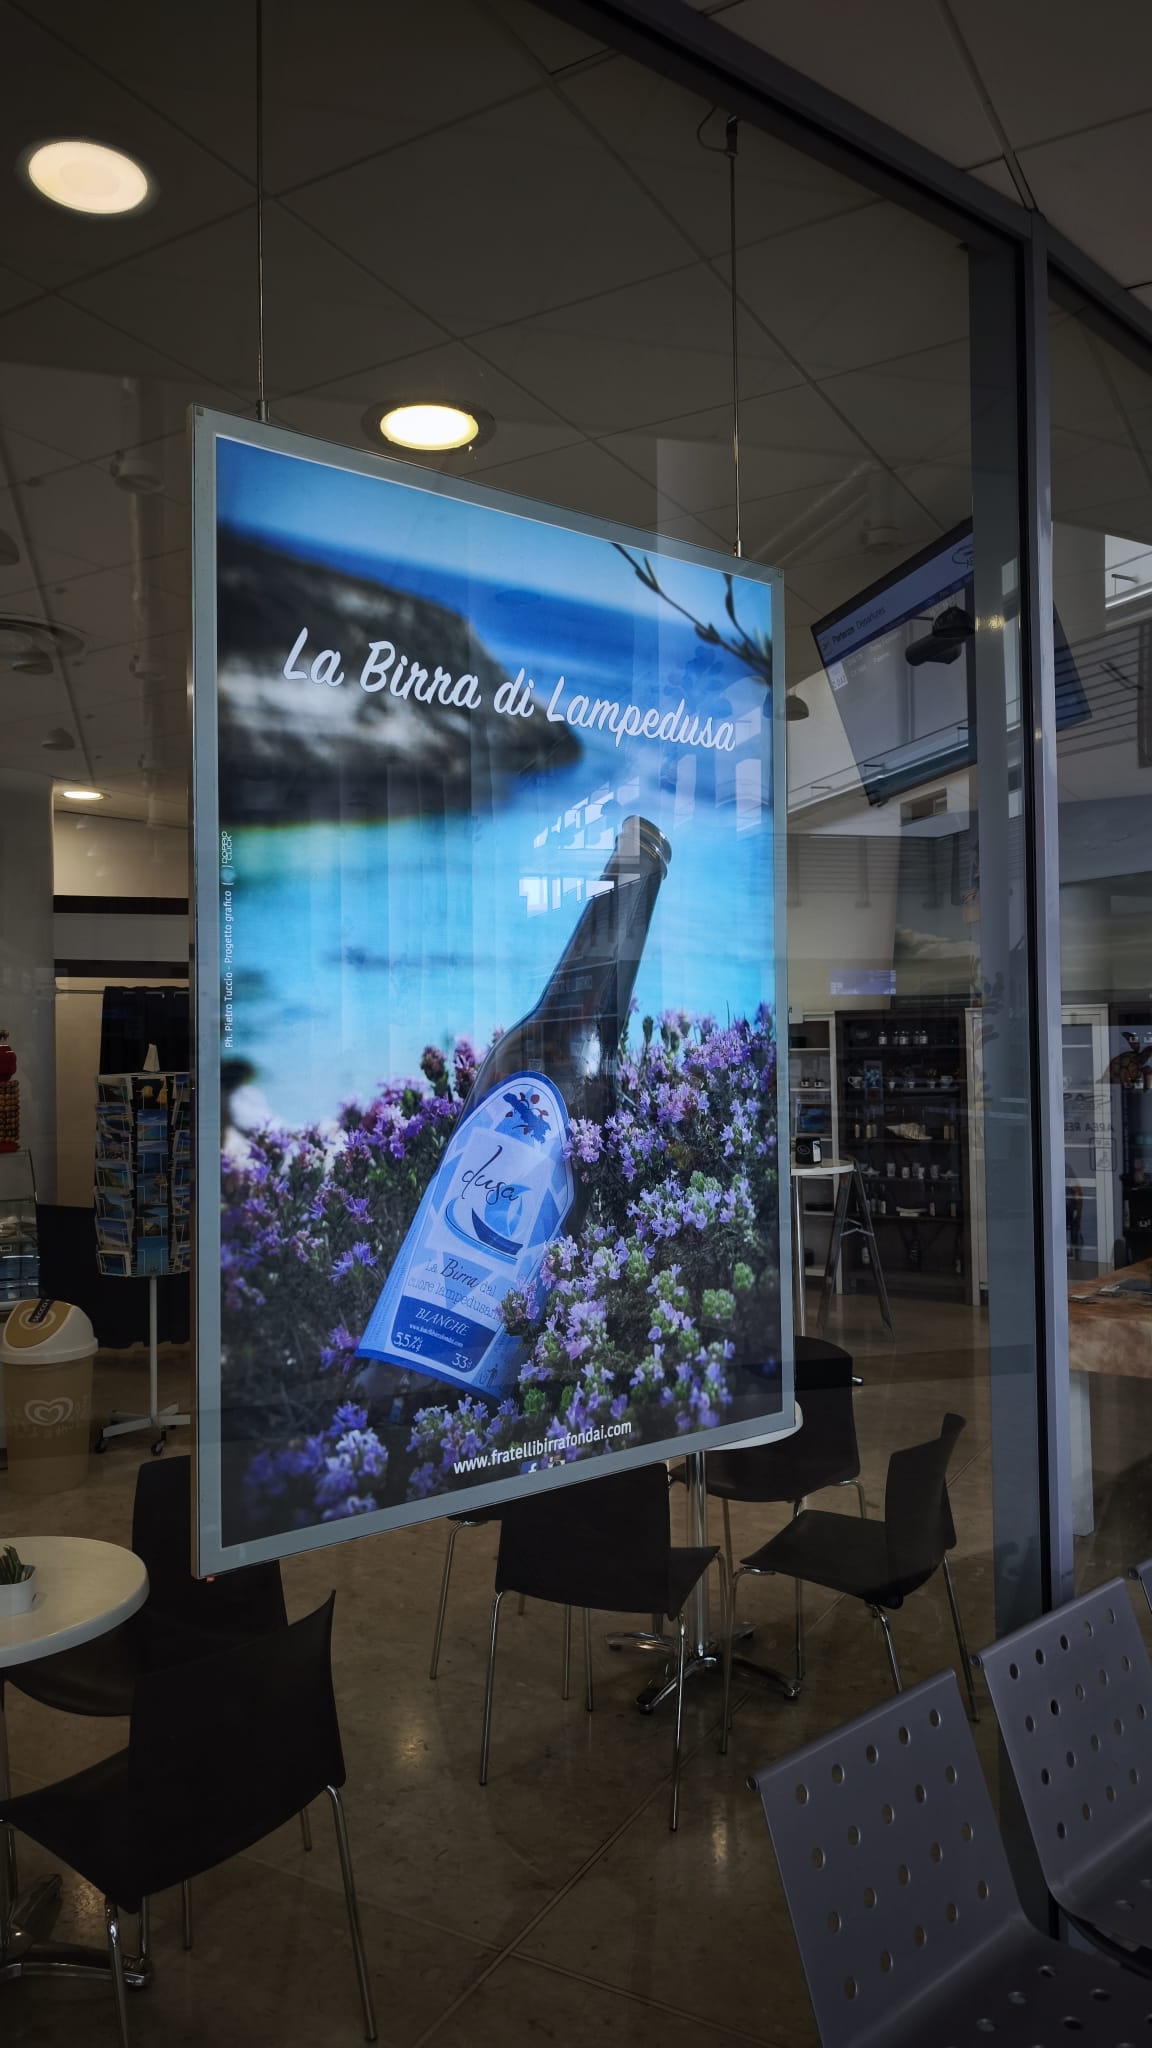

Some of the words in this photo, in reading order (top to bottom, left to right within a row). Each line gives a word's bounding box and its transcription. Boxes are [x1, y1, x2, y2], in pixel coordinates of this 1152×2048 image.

[283, 627, 345, 687] La
[359, 640, 482, 710] Birra
[493, 667, 536, 718] di
[546, 675, 736, 752] Lampedusa
[224, 891, 234, 922] grafico
[224, 924, 234, 964] Progetto
[224, 973, 233, 1001] Tuccio
[224, 1004, 233, 1031] Pietro
[224, 1034, 233, 1048] Ph.
[440, 1258, 480, 1288] Birra
[479, 1281, 497, 1297] dal
[435, 1282, 498, 1320] lampedusan
[415, 1307, 470, 1336] BLANCHE
[453, 1421, 632, 1475] www.fratellibirrafondai.com
